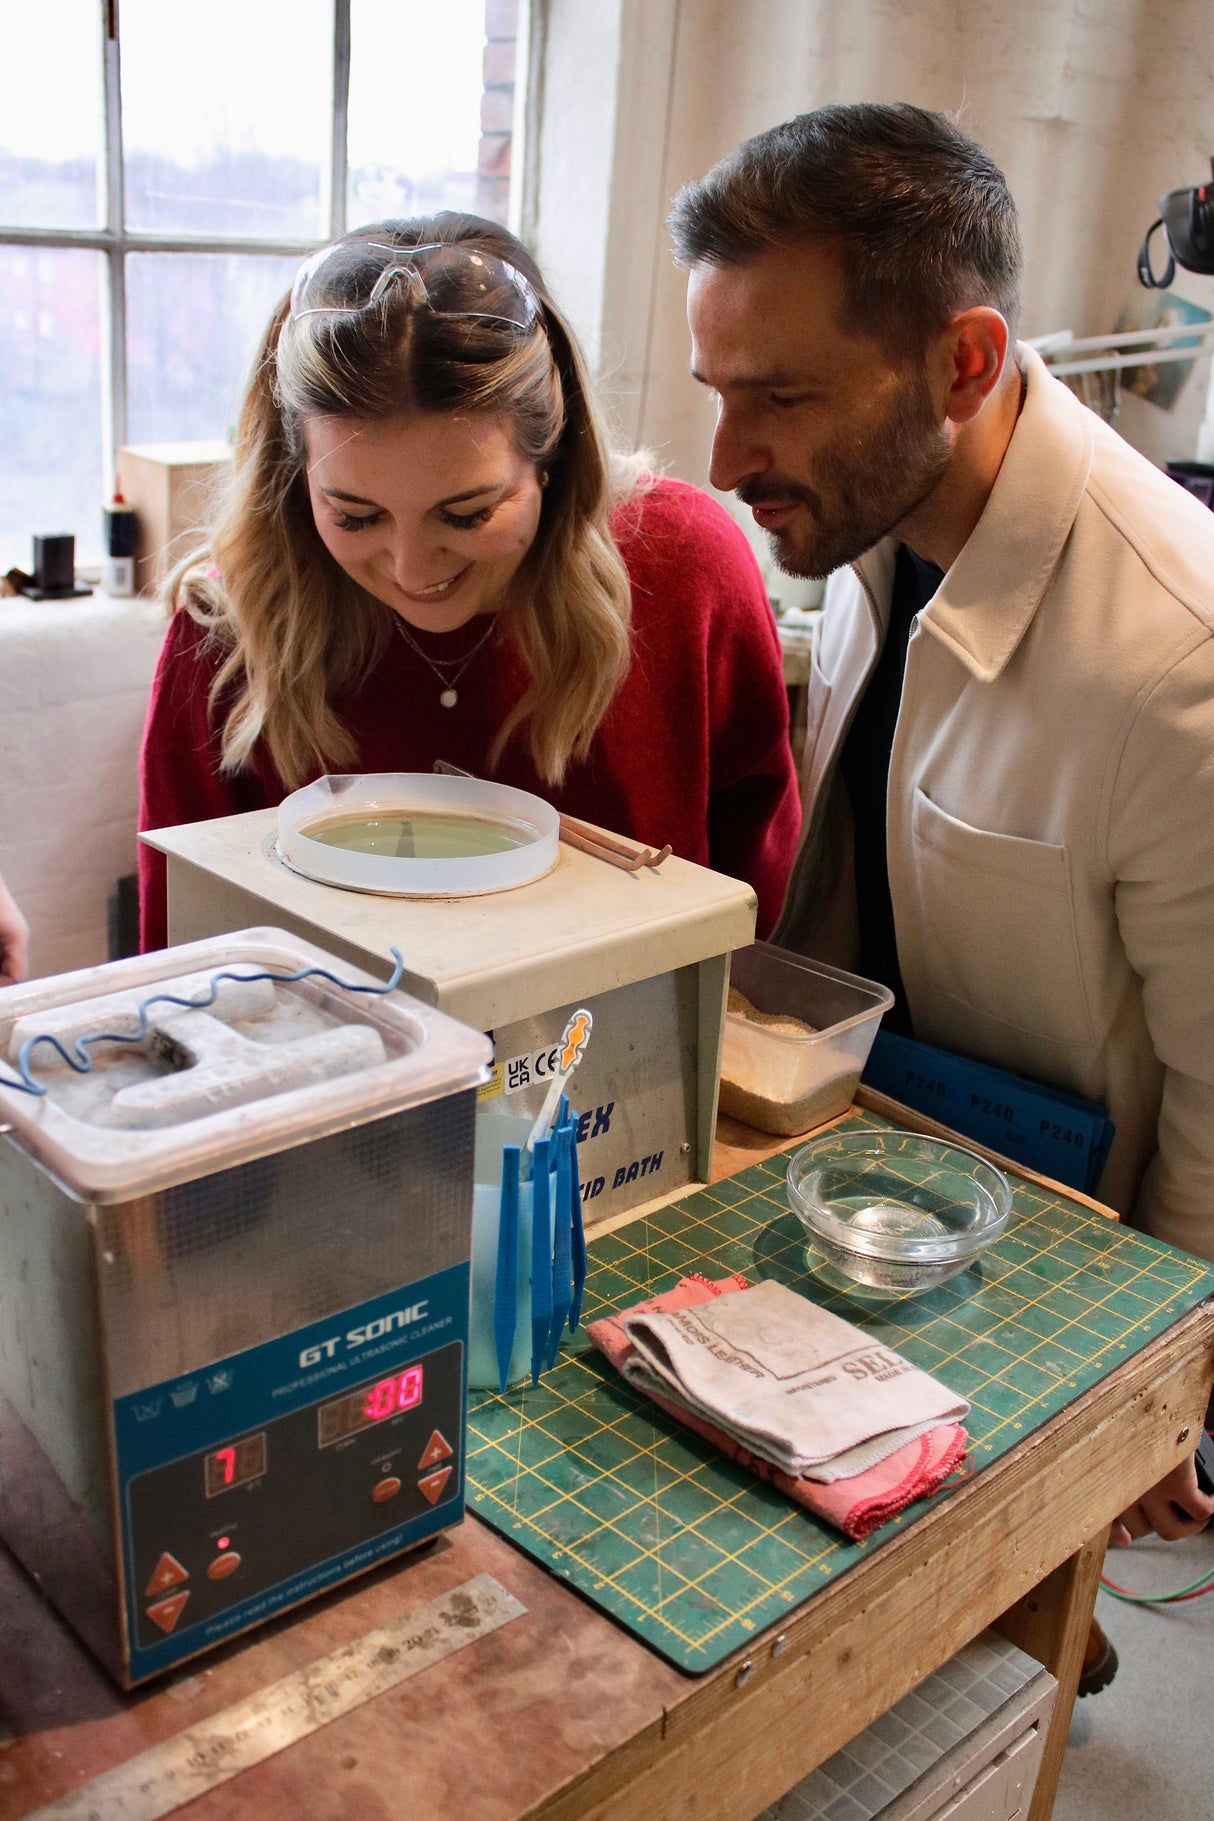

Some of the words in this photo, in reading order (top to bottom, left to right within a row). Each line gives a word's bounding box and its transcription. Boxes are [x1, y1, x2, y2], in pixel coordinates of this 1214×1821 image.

[508, 1057, 529, 1075] UK
[509, 1071, 530, 1089] CA
[905, 1071, 946, 1097] P240
[971, 1095, 1014, 1122] P240
[576, 1102, 615, 1144] EX
[1039, 1120, 1084, 1148] P240
[612, 1150, 664, 1189] BATH
[300, 1335, 341, 1368] GT
[346, 1300, 429, 1350] SONIC
[272, 1361, 347, 1397] PROFESSIONAL
[350, 1335, 408, 1367] ULTRASONIC
[410, 1316, 453, 1341] CLEANER
[707, 1342, 765, 1379] LEATHER
[343, 1549, 374, 1569] before
